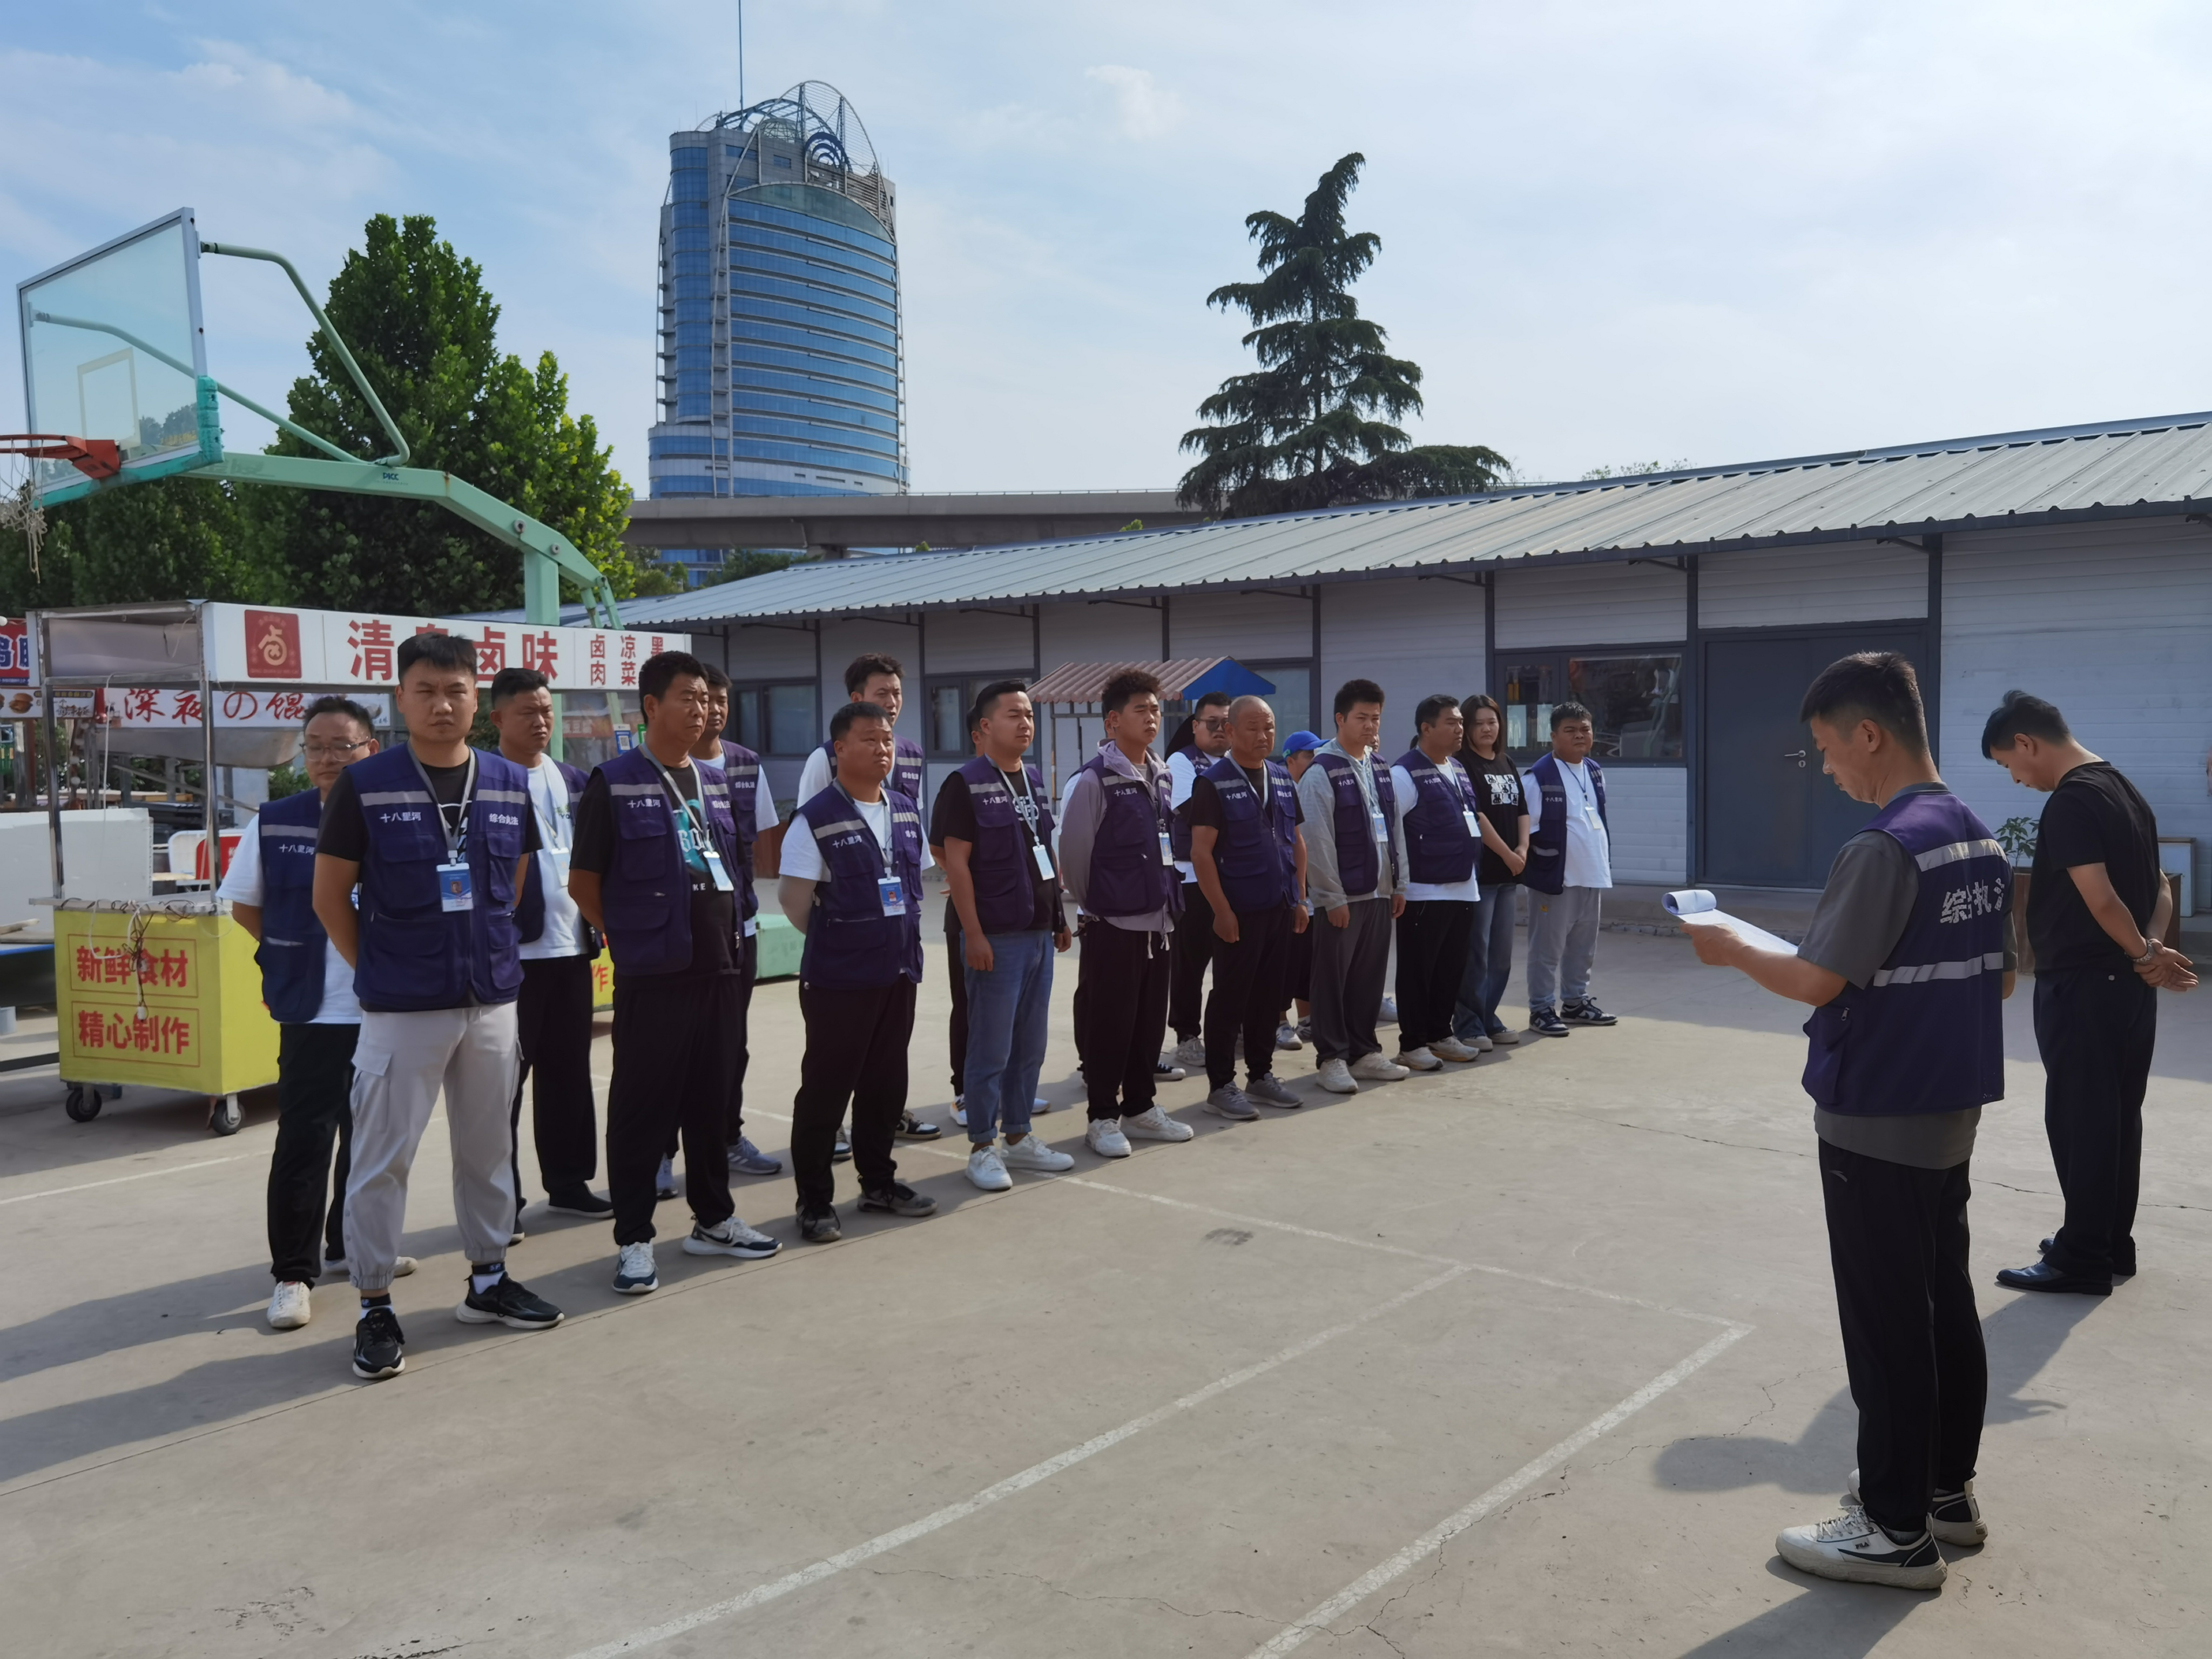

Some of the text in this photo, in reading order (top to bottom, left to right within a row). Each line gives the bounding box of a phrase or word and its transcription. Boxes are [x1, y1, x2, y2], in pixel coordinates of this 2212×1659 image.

[347, 619, 558, 684] 清卤味
[621, 635, 637, 686] 凉菜
[76, 945, 189, 988] 新鲜食材
[78, 1009, 190, 1055] 精心制作
[1855, 1542, 1870, 1550] FILA
